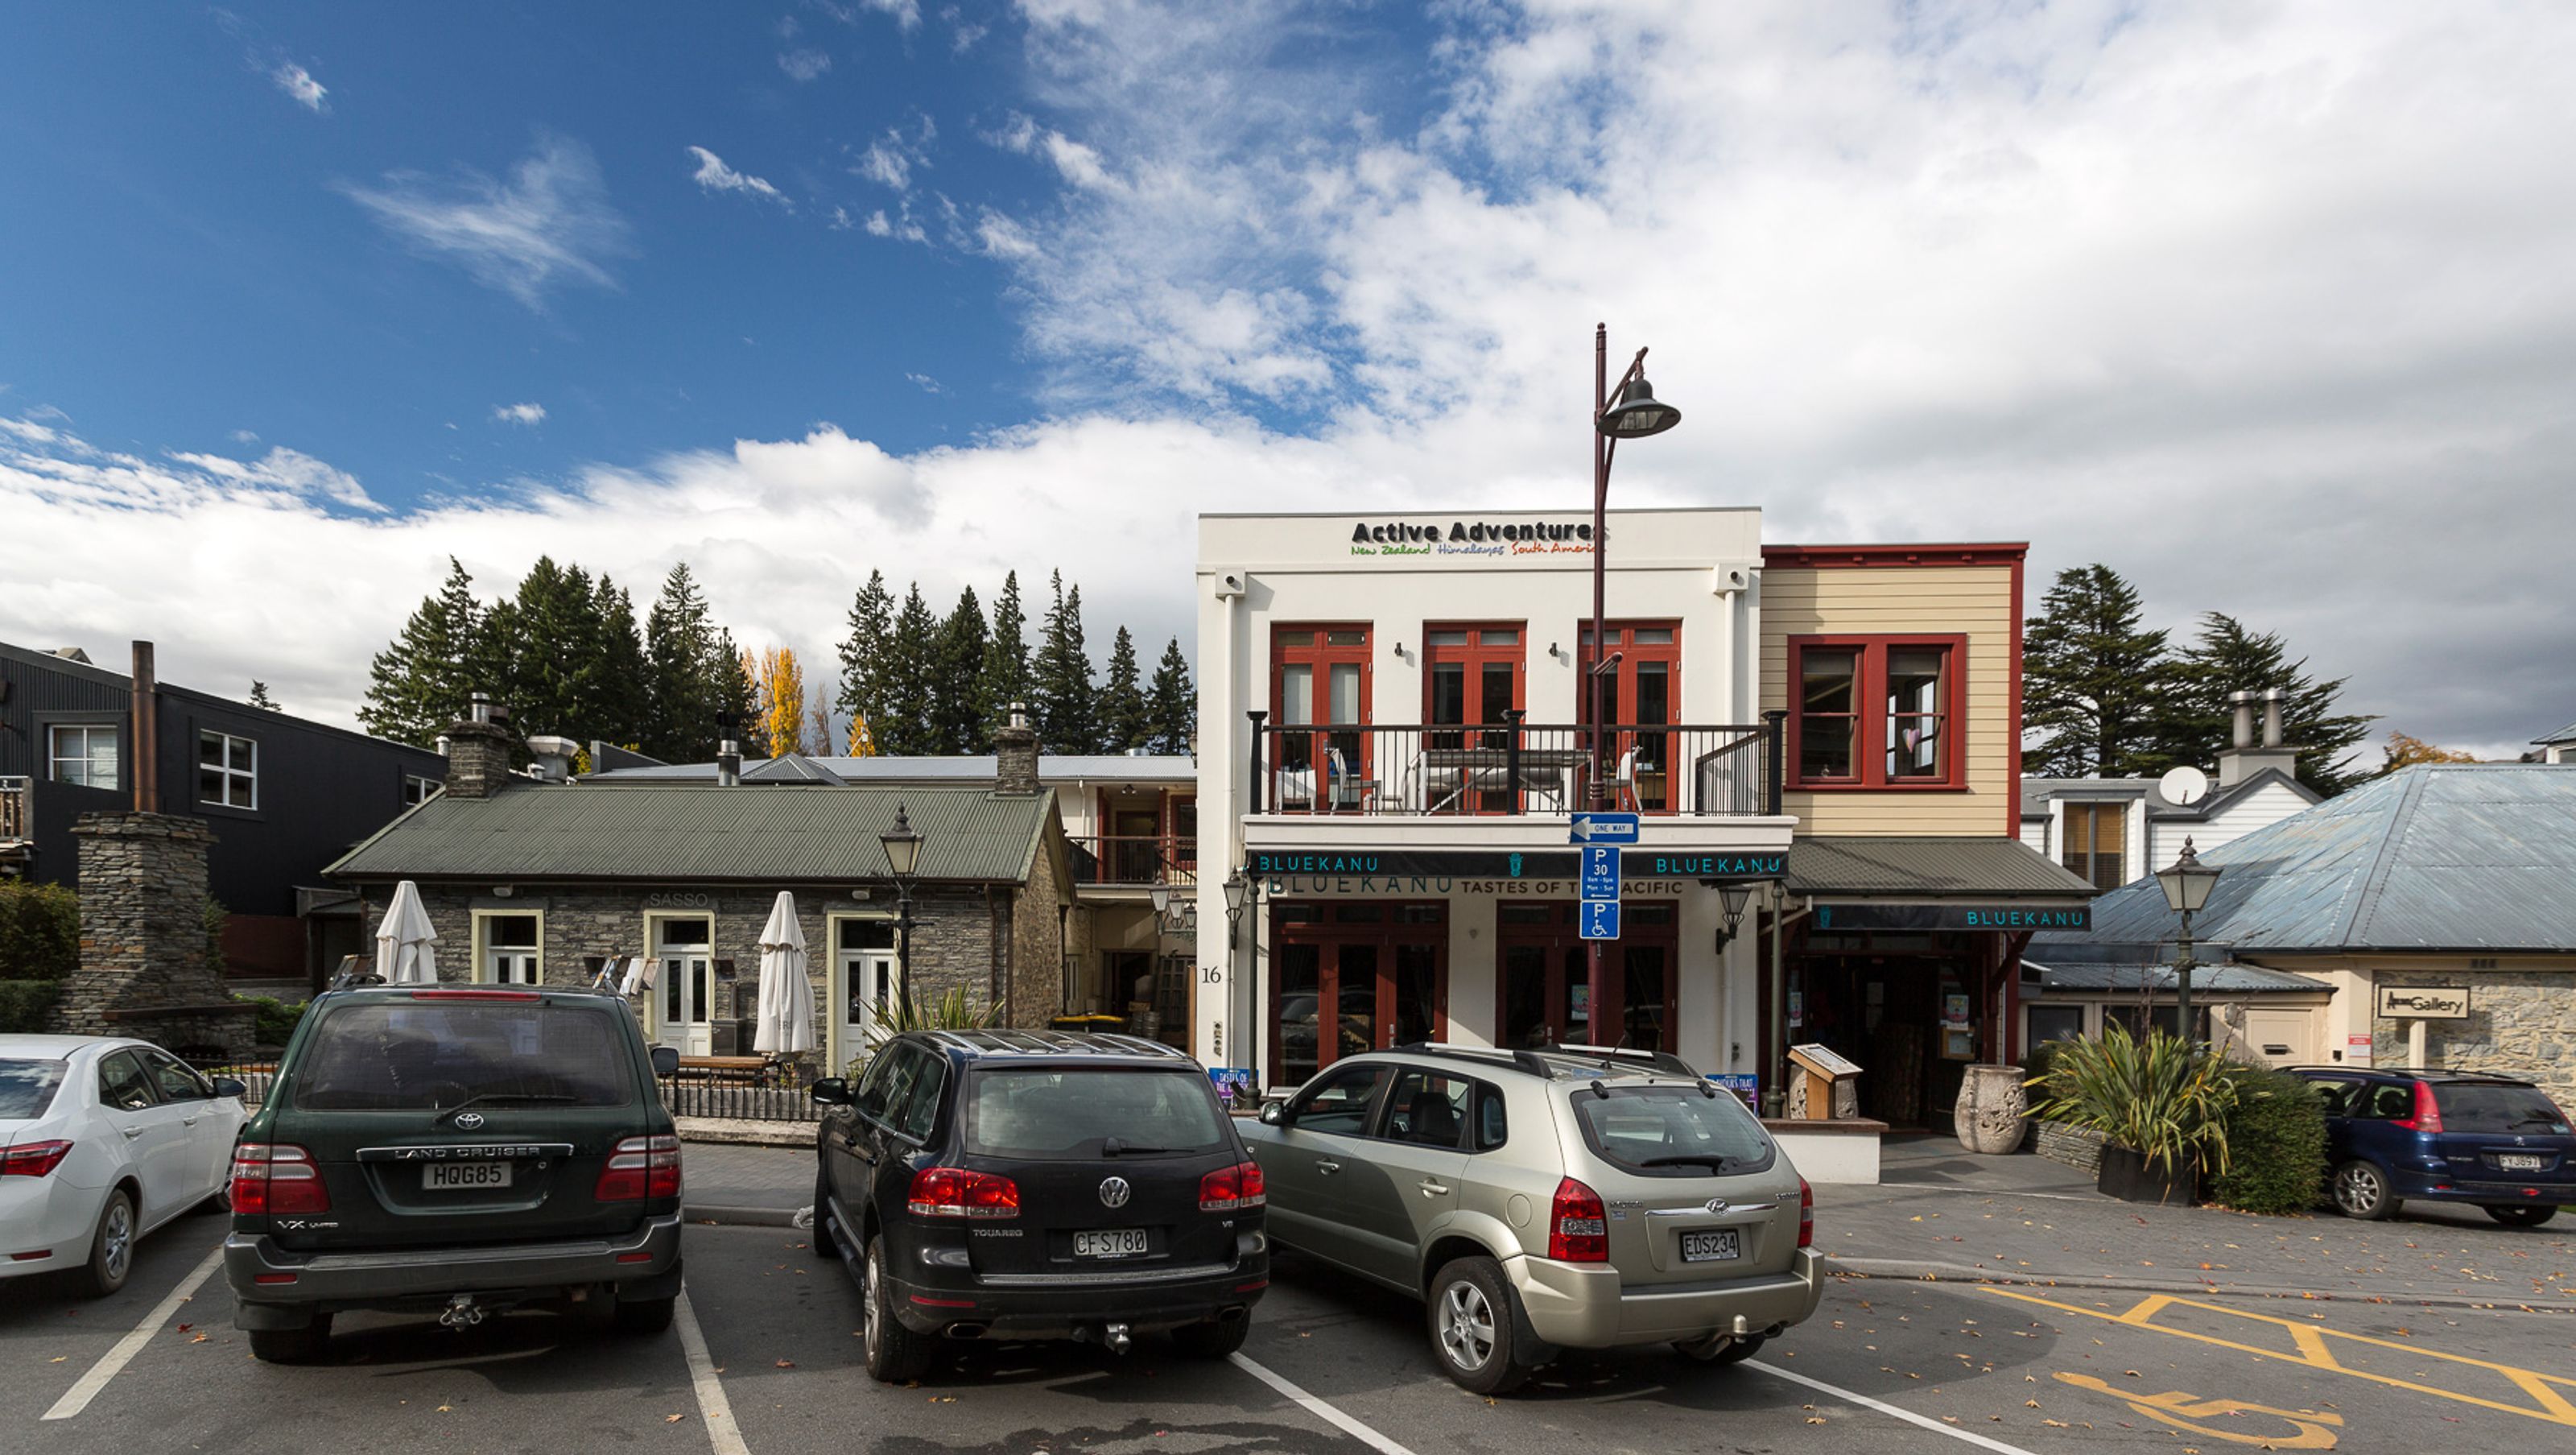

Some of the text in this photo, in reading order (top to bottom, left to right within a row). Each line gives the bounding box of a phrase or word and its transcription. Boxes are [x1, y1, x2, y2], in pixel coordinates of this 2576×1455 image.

[1352, 522, 1602, 543] Active Adventure
[1351, 541, 1604, 557] New Zealand Himalayas South Americ
[1595, 825, 1627, 833] ONE WAY
[1595, 849, 1607, 862] P
[1259, 856, 1378, 871] BLUEKANU
[1594, 864, 1608, 876] 30
[1655, 858, 1781, 873] BLUEKANU
[1269, 876, 1452, 893] BLUEKANU
[1461, 882, 1529, 895] TASTES
[1536, 882, 1561, 895] OF
[1620, 882, 1683, 895] ACIFIC
[650, 892, 708, 907] SASSO
[1594, 903, 1607, 918] P
[1967, 911, 2083, 926] BLUEKANU
[1202, 965, 1221, 983] 16
[2410, 996, 2463, 1015] Gallery
[394, 1147, 541, 1159] LAND CRUISER
[433, 1165, 502, 1186] HQG85
[277, 1221, 305, 1230] VX
[1075, 1230, 1146, 1255] CFS780
[1684, 1234, 1738, 1256] EDS234
